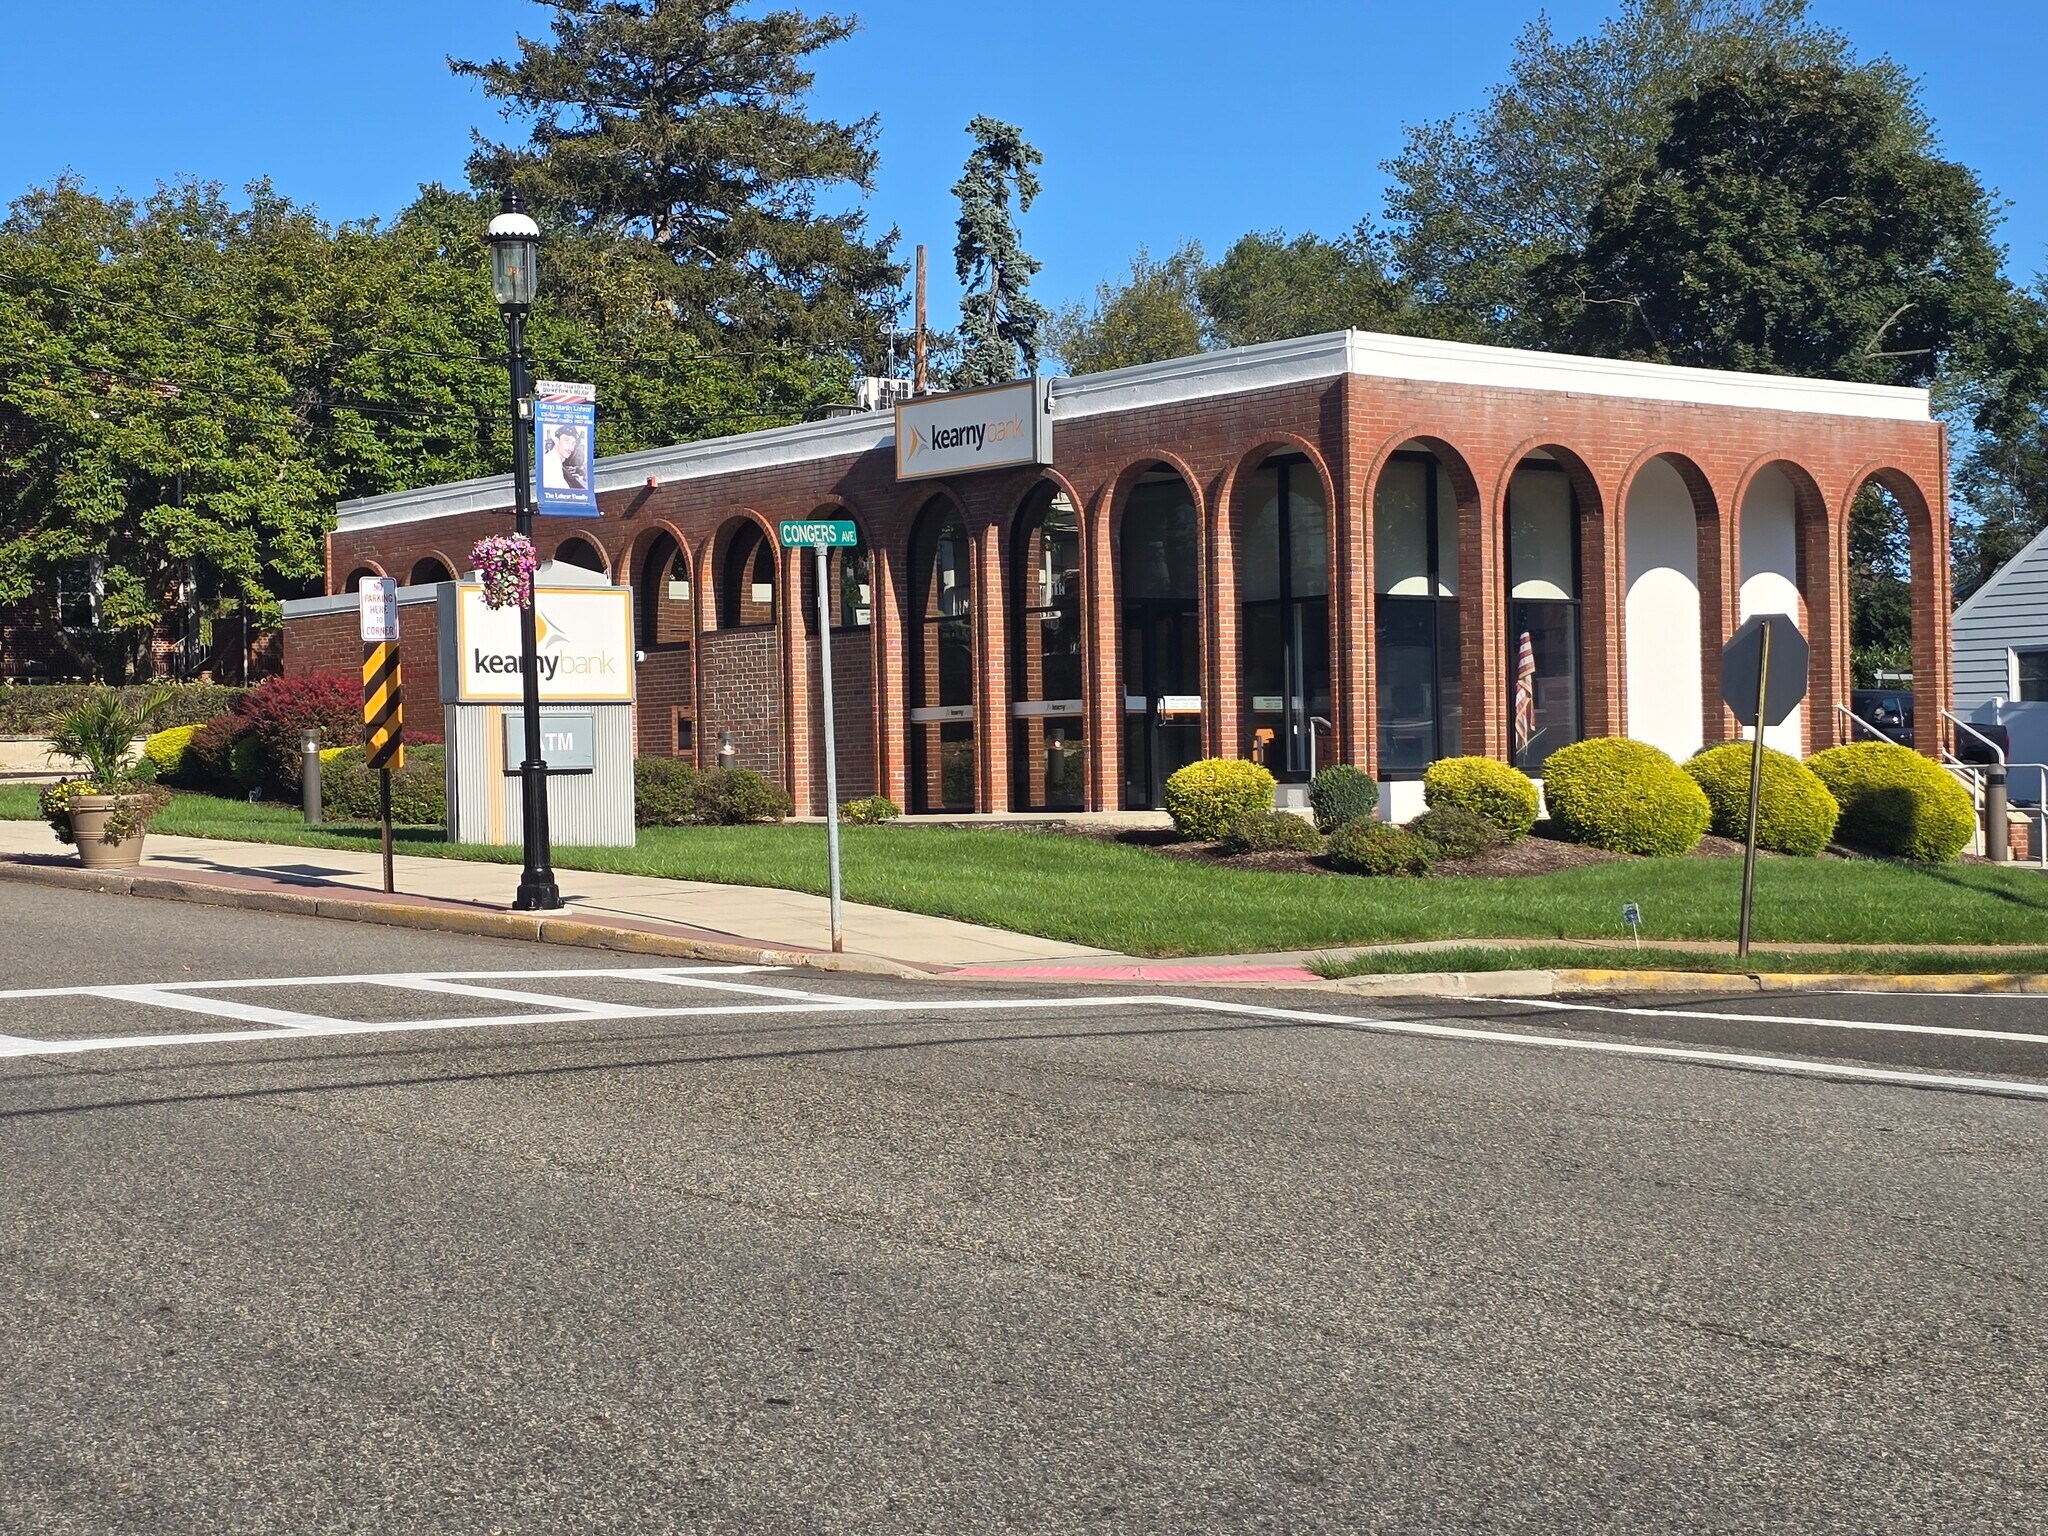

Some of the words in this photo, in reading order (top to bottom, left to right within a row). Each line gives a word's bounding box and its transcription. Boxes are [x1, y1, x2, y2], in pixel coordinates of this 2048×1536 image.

[572, 493, 588, 501] Family
[782, 524, 837, 543] CONGERS
[841, 530, 855, 542] AVE
[373, 581, 384, 591] NO
[364, 593, 394, 603] PARKING
[370, 605, 389, 614] HERE
[376, 616, 384, 624] TO
[366, 626, 394, 636] CORNER
[540, 732, 574, 751] TM
